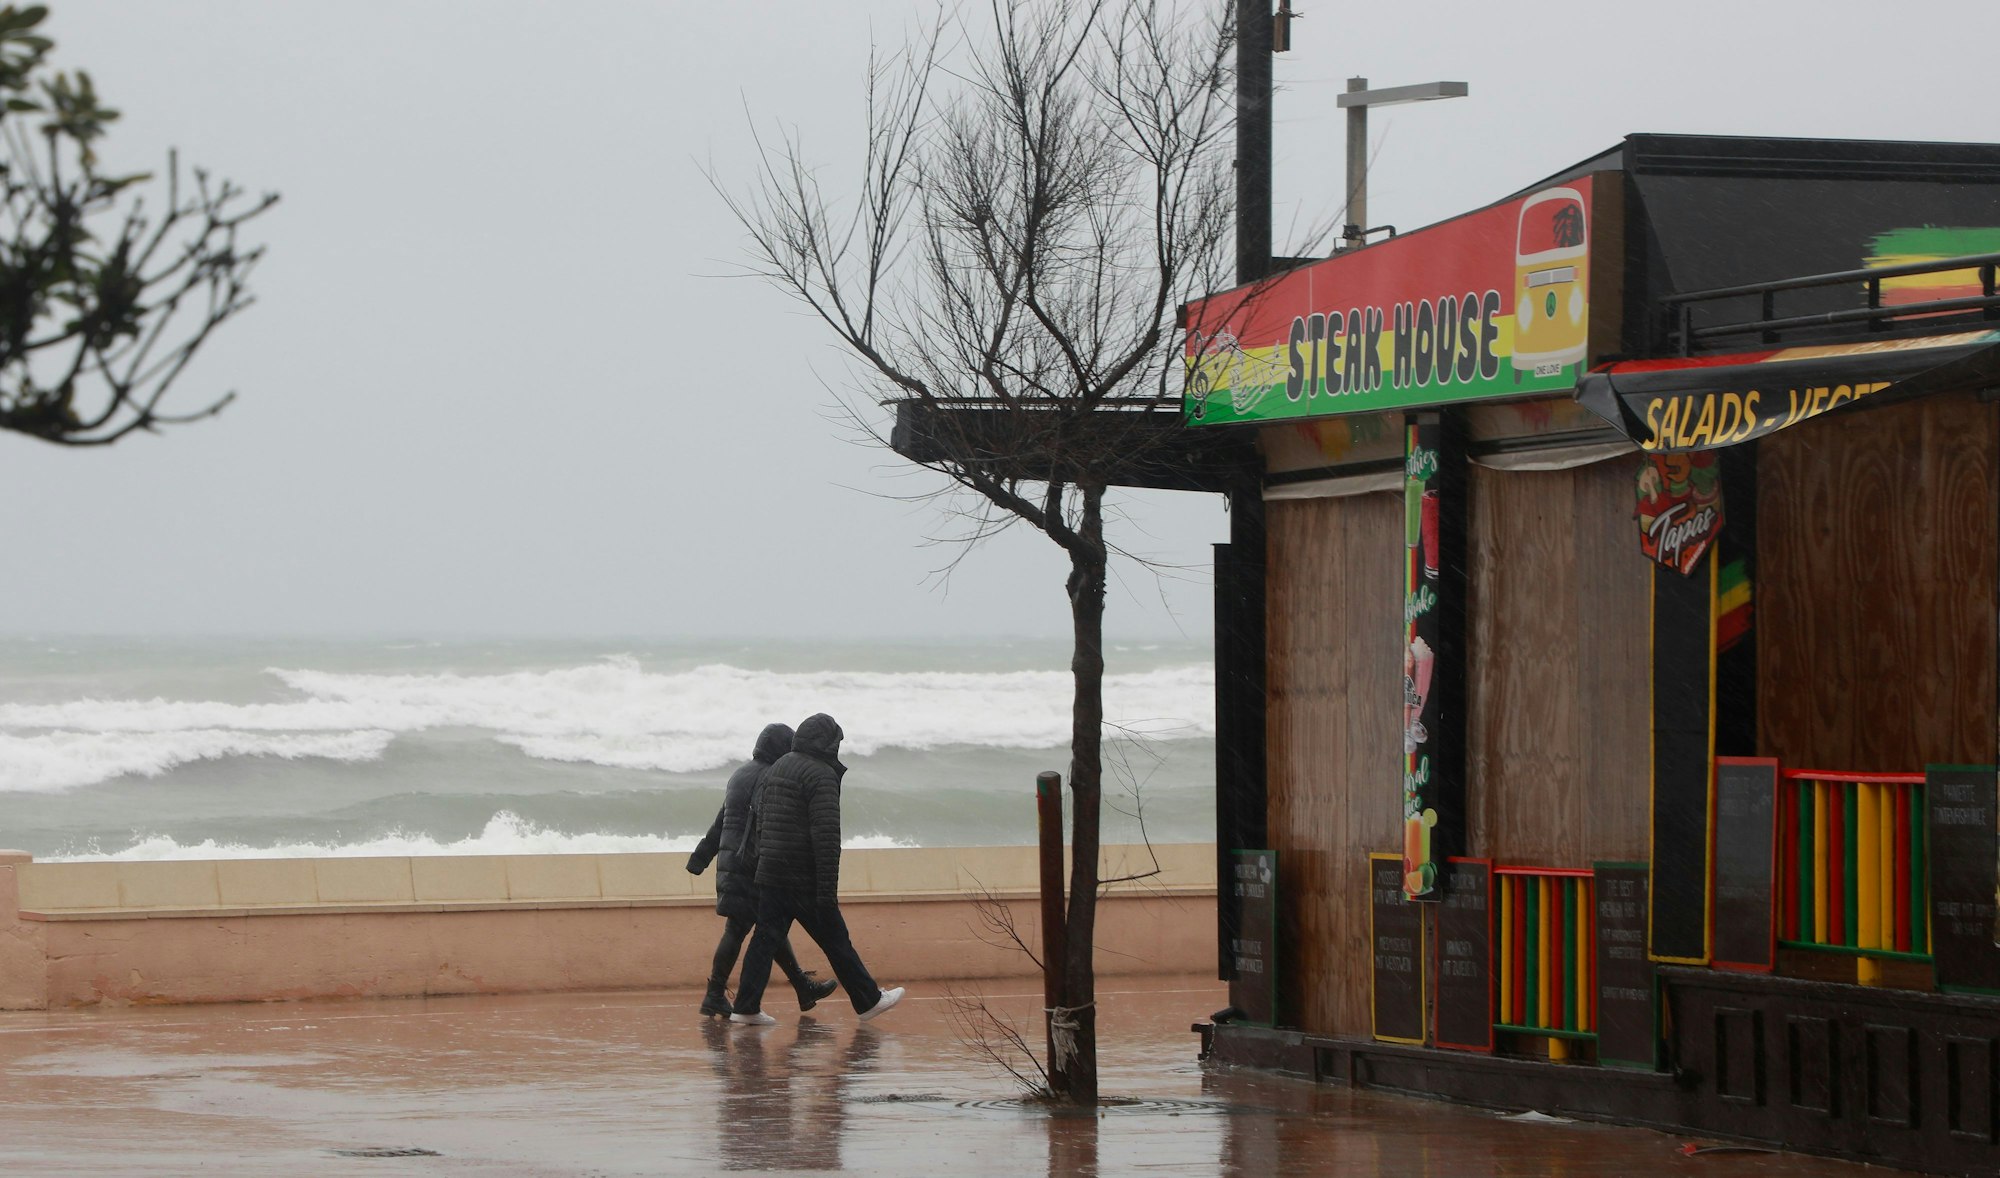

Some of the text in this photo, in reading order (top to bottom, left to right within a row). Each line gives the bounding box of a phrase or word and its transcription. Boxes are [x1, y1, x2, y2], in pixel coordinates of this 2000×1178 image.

[1286, 289, 1501, 402] STEAK HOUSE
[1642, 390, 1760, 451] SALADS
[1649, 503, 1716, 567] Tapas
